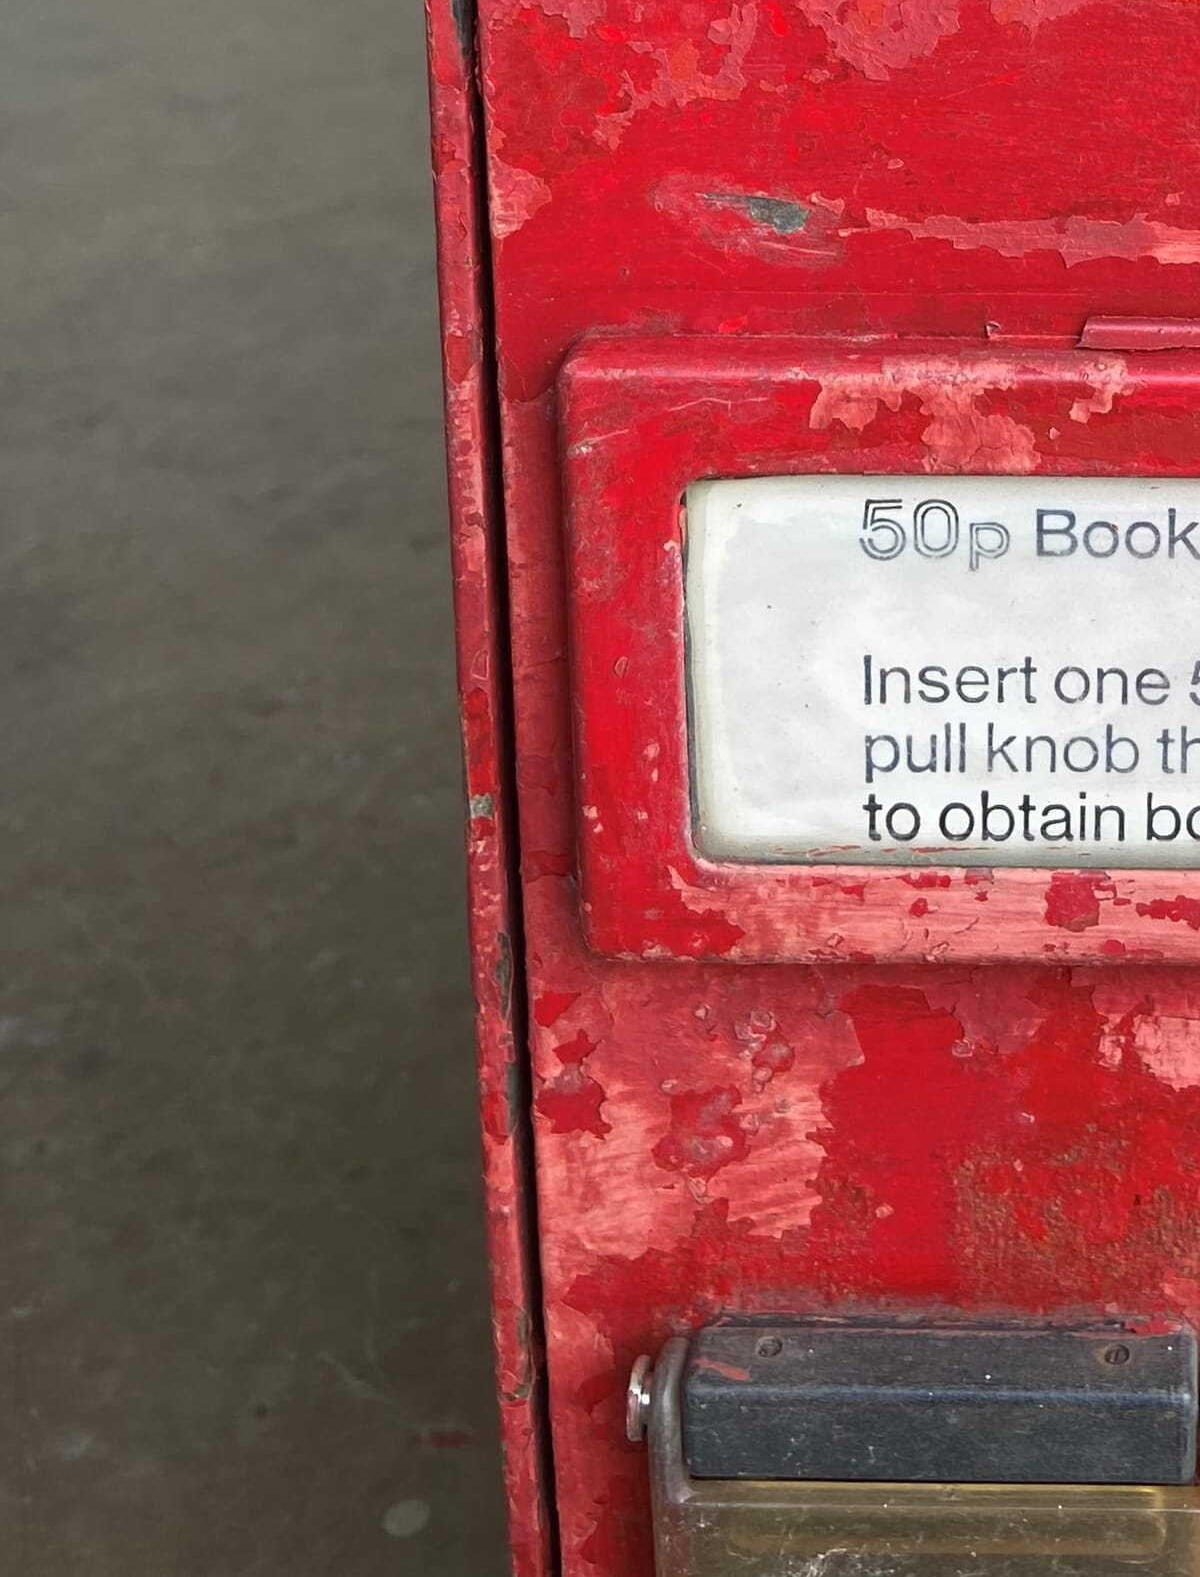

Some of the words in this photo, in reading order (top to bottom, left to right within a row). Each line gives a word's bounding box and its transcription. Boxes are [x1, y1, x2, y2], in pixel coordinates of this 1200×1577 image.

[858, 498, 1011, 573] 50p
[863, 654, 1038, 706] Insert
[1053, 665, 1171, 707] one
[863, 721, 967, 785] pull
[986, 721, 1140, 775] knob
[861, 793, 921, 843] to
[938, 789, 1126, 843] obtain
